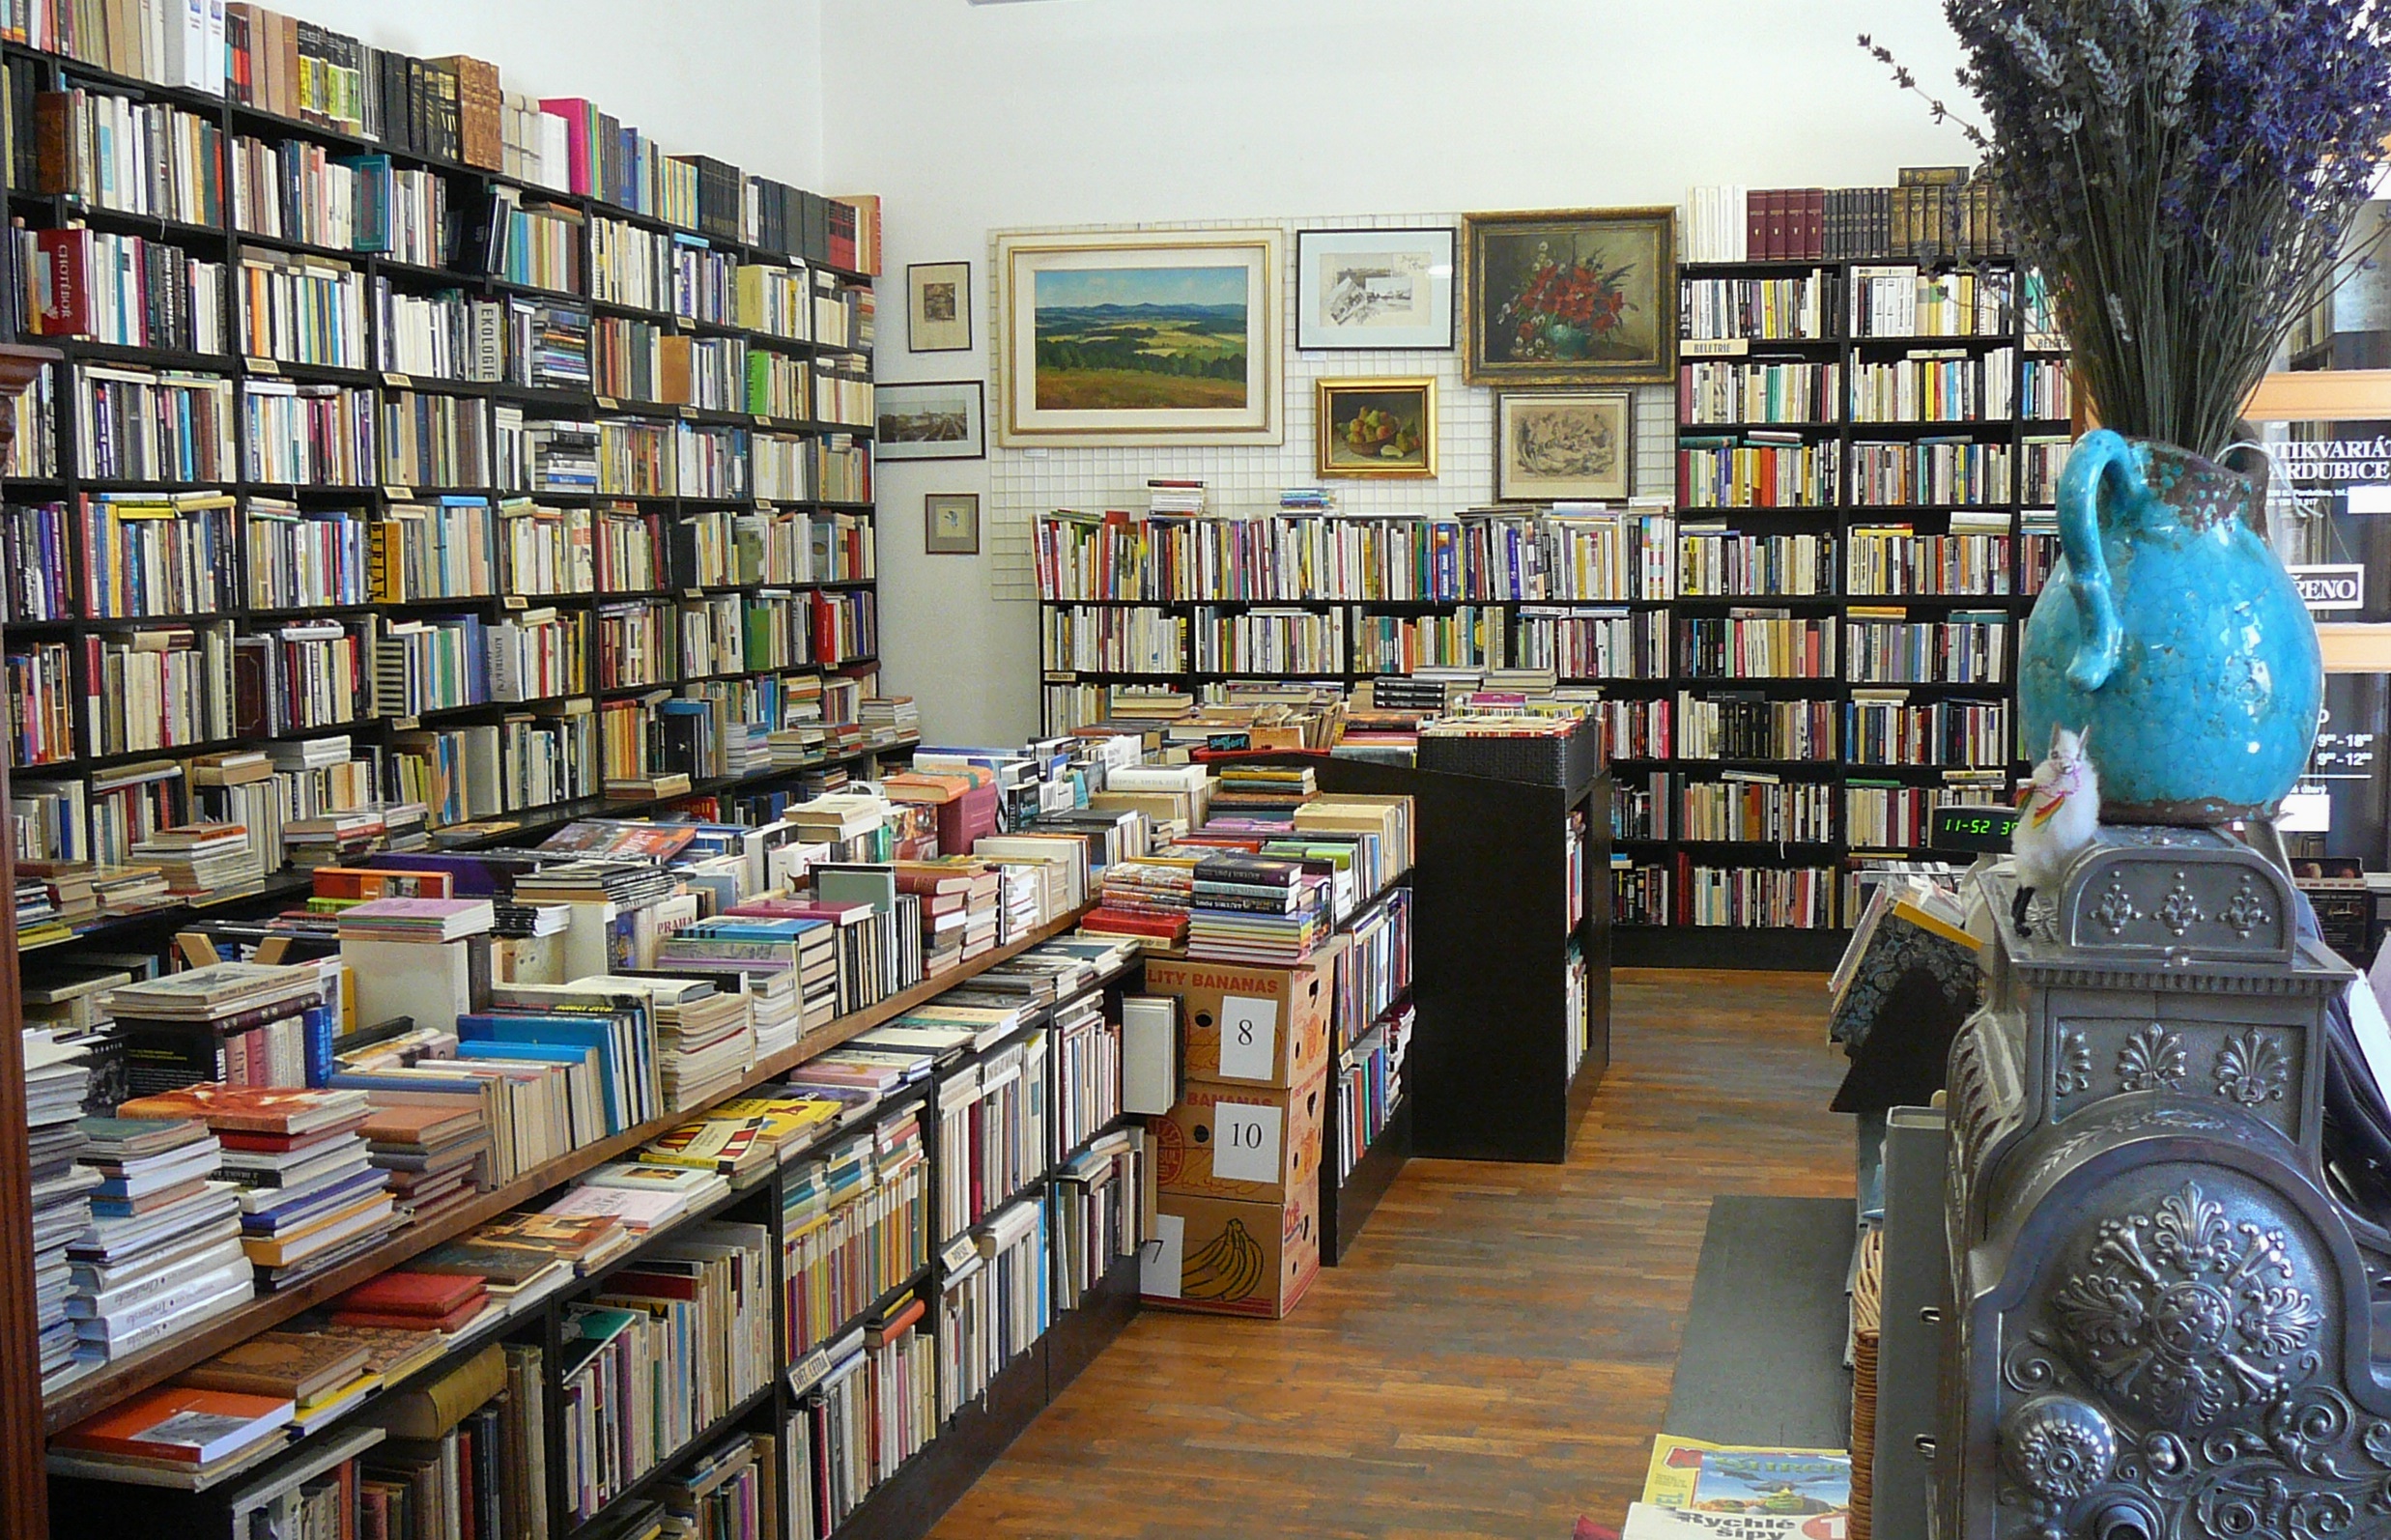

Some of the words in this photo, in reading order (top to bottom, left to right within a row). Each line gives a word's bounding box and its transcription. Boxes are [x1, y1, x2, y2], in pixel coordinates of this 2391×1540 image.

[58, 244, 73, 319] CHOTĚBOŘ
[480, 307, 497, 381] EKOLOGIE
[1694, 343, 1731, 355] BELETRIE
[2268, 461, 2391, 480] RDUBICE
[371, 523, 385, 599] BURIAN
[2291, 574, 2357, 600] ŘENO
[657, 916, 694, 935] PRAHA
[1147, 970, 1186, 985] LITY
[1191, 973, 1279, 994] BANANAS
[1238, 1019, 1253, 1046] 8
[1231, 1122, 1263, 1150] 10
[1676, 1511, 1796, 1530] Rychlé
